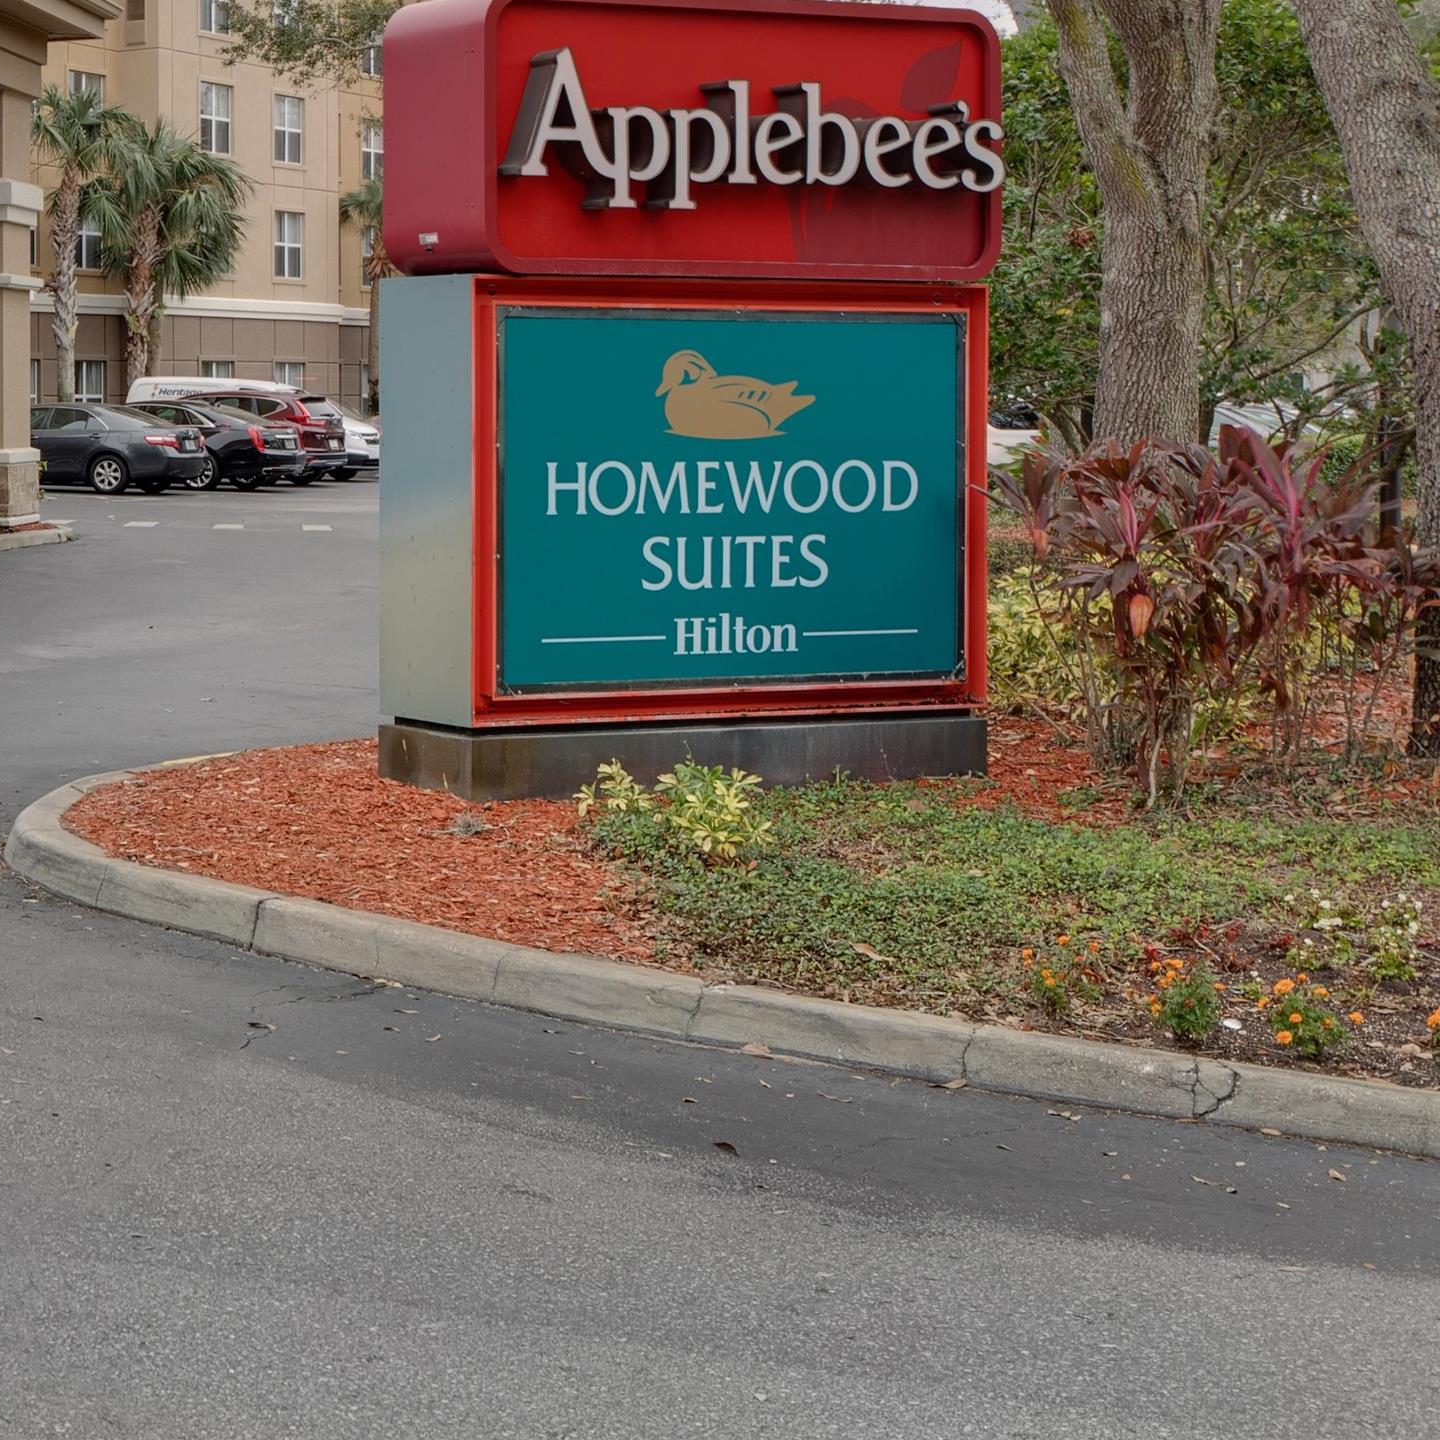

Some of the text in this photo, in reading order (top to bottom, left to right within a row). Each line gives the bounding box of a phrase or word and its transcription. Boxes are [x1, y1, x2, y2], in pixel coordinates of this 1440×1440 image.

[499, 46, 1006, 210] Applebee's
[546, 459, 919, 516] HOMEWOOD
[641, 534, 830, 591] SUITES
[673, 613, 799, 656] Hilton
